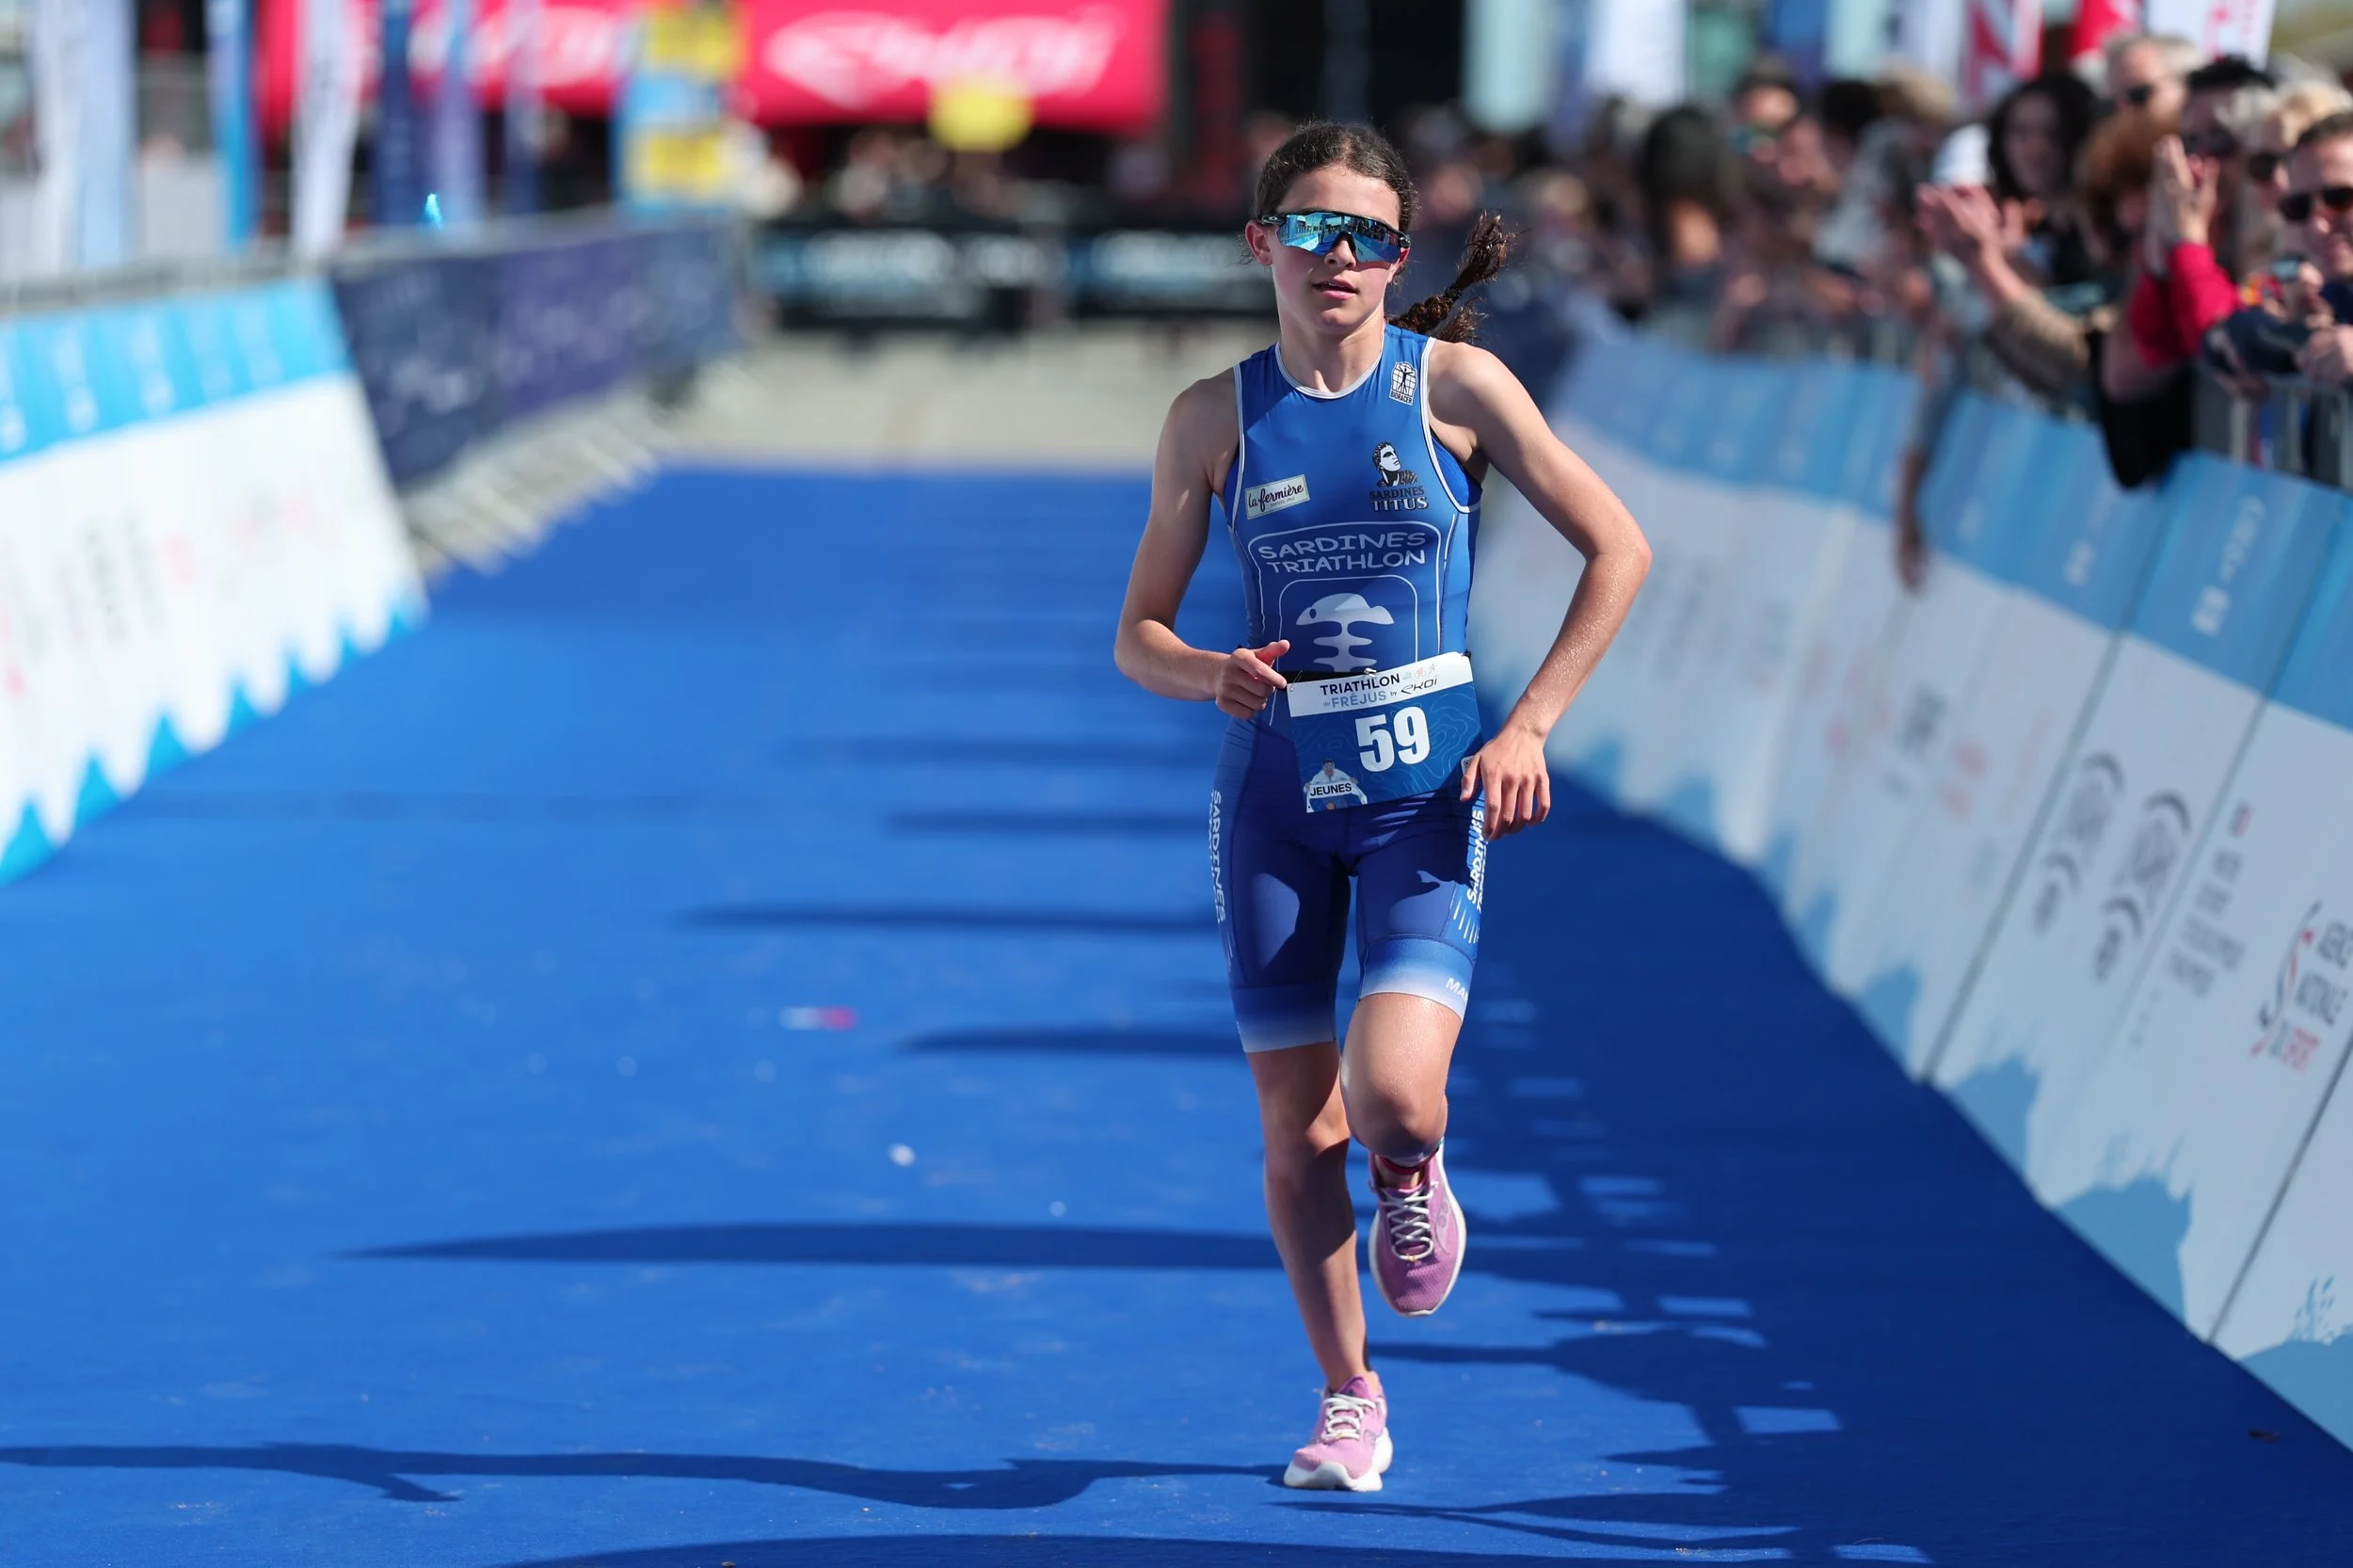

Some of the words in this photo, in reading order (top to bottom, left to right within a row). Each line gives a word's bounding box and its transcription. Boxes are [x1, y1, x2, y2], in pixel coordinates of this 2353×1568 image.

[1257, 484, 1305, 512] fermière
[1369, 486, 1425, 500] SARDINES
[1370, 496, 1430, 512] TITUS
[1257, 532, 1426, 559] SARDINES
[1266, 550, 1426, 574] TRIATHLON
[1320, 673, 1401, 696] TRIATHLON
[1332, 690, 1387, 708] FRÉJUS
[1354, 706, 1431, 772] 59
[1310, 783, 1352, 797] JEUNES
[1211, 790, 1226, 921] SARDINES
